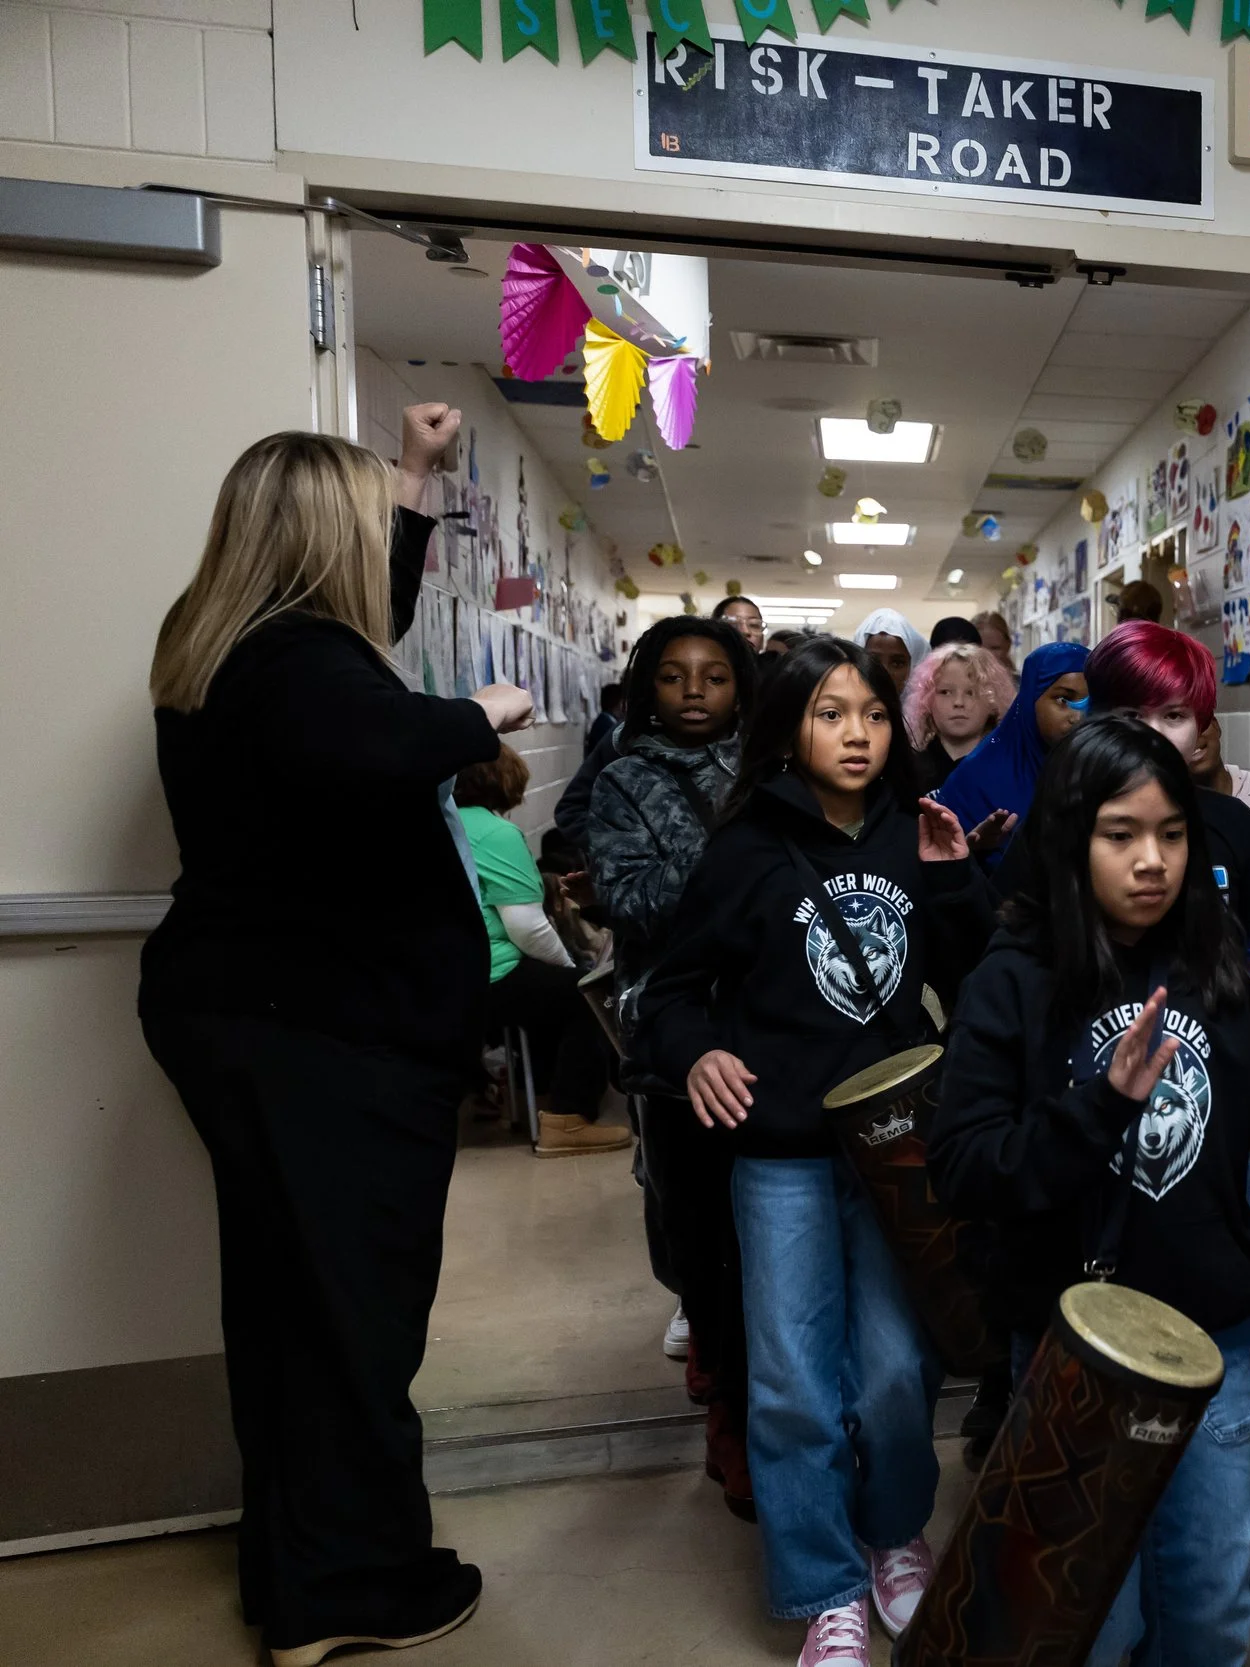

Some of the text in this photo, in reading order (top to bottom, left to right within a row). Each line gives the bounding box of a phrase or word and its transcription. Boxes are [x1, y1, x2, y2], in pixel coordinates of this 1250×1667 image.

[654, 38, 828, 100] RISK
[917, 66, 1113, 130] TAKER
[907, 132, 1072, 188] ROAD
[793, 873, 914, 924] WHTIER WOLVES
[1163, 1007, 1211, 1059] OLVES
[869, 1122, 910, 1145] REMO
